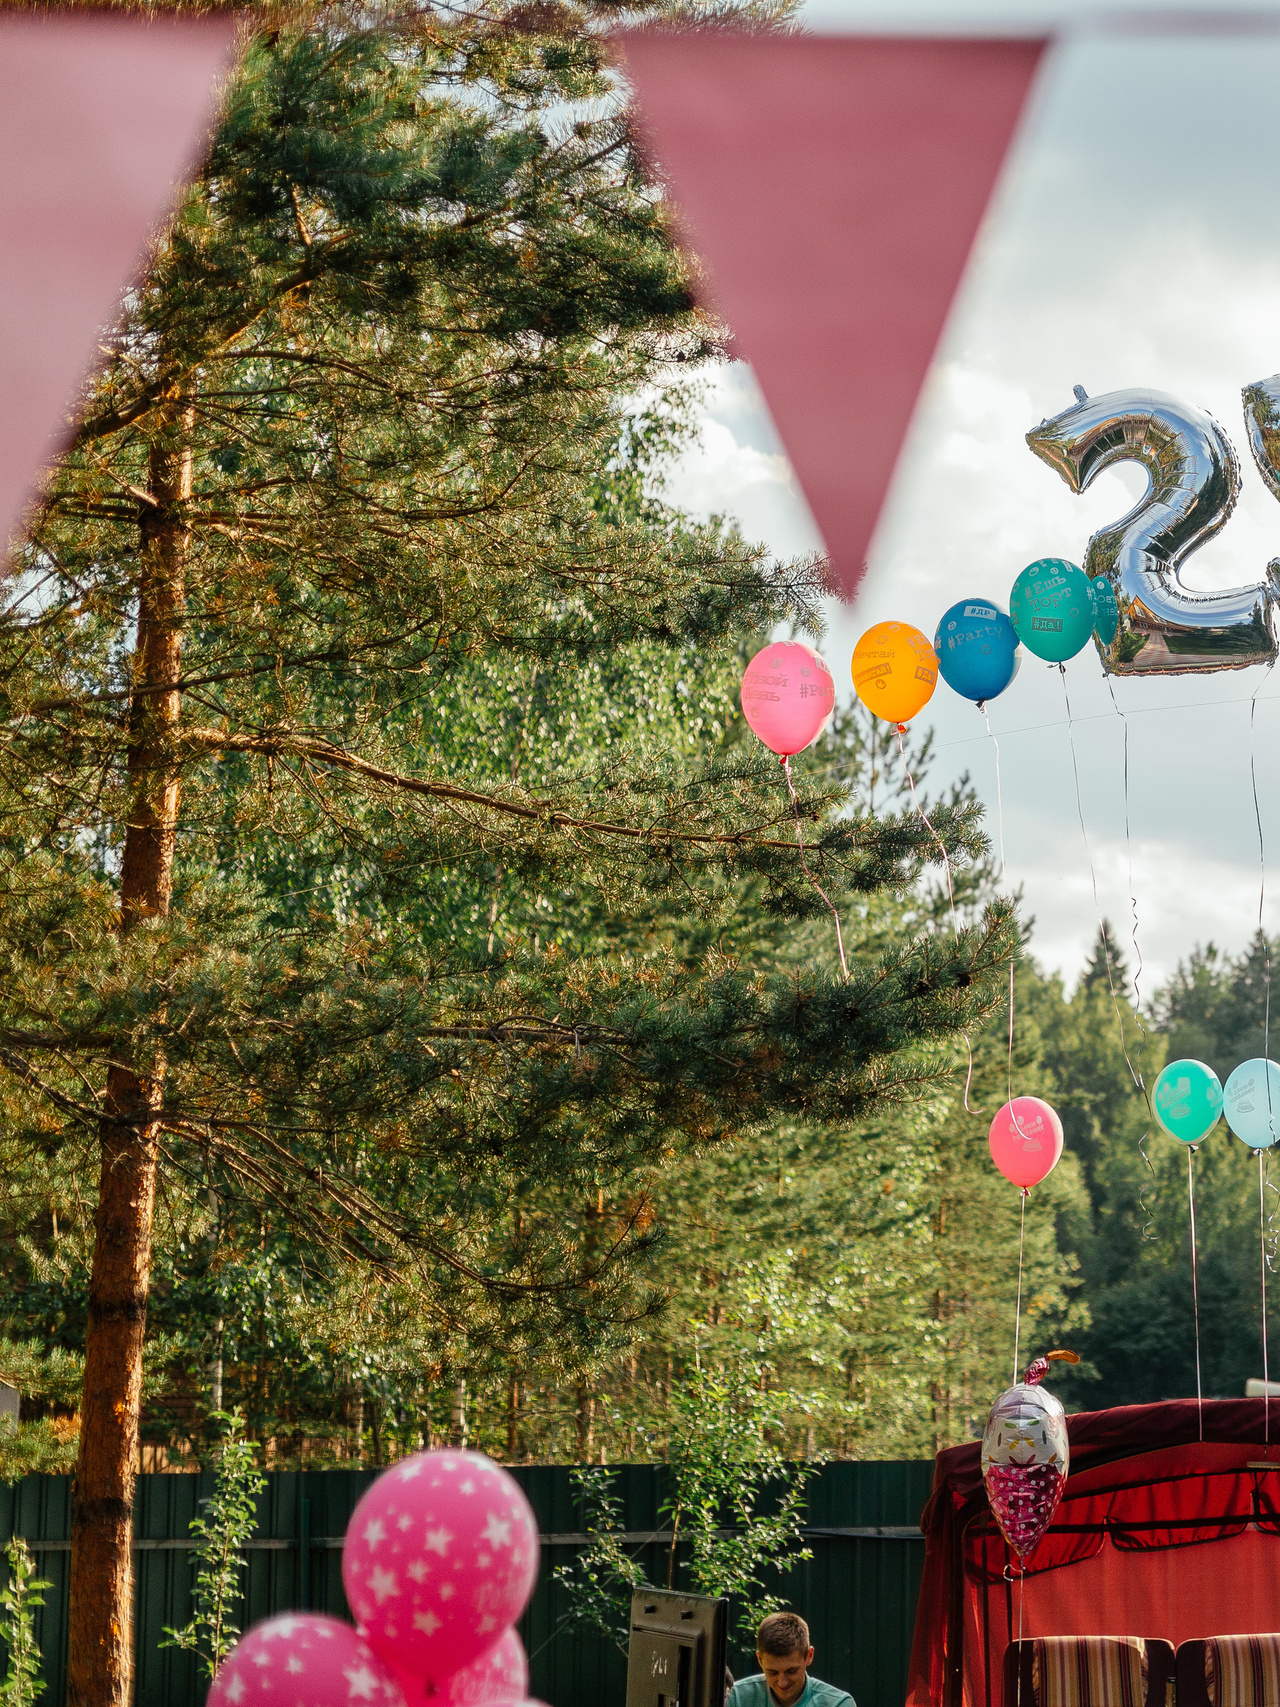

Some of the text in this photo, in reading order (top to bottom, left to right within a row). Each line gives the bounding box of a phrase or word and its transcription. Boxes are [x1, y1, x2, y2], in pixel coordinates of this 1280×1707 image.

[1024, 576, 1067, 601] #Ешь
[1029, 587, 1072, 612] Торт
[1032, 619, 1061, 630] #Да!
[947, 625, 1003, 651] #Party
